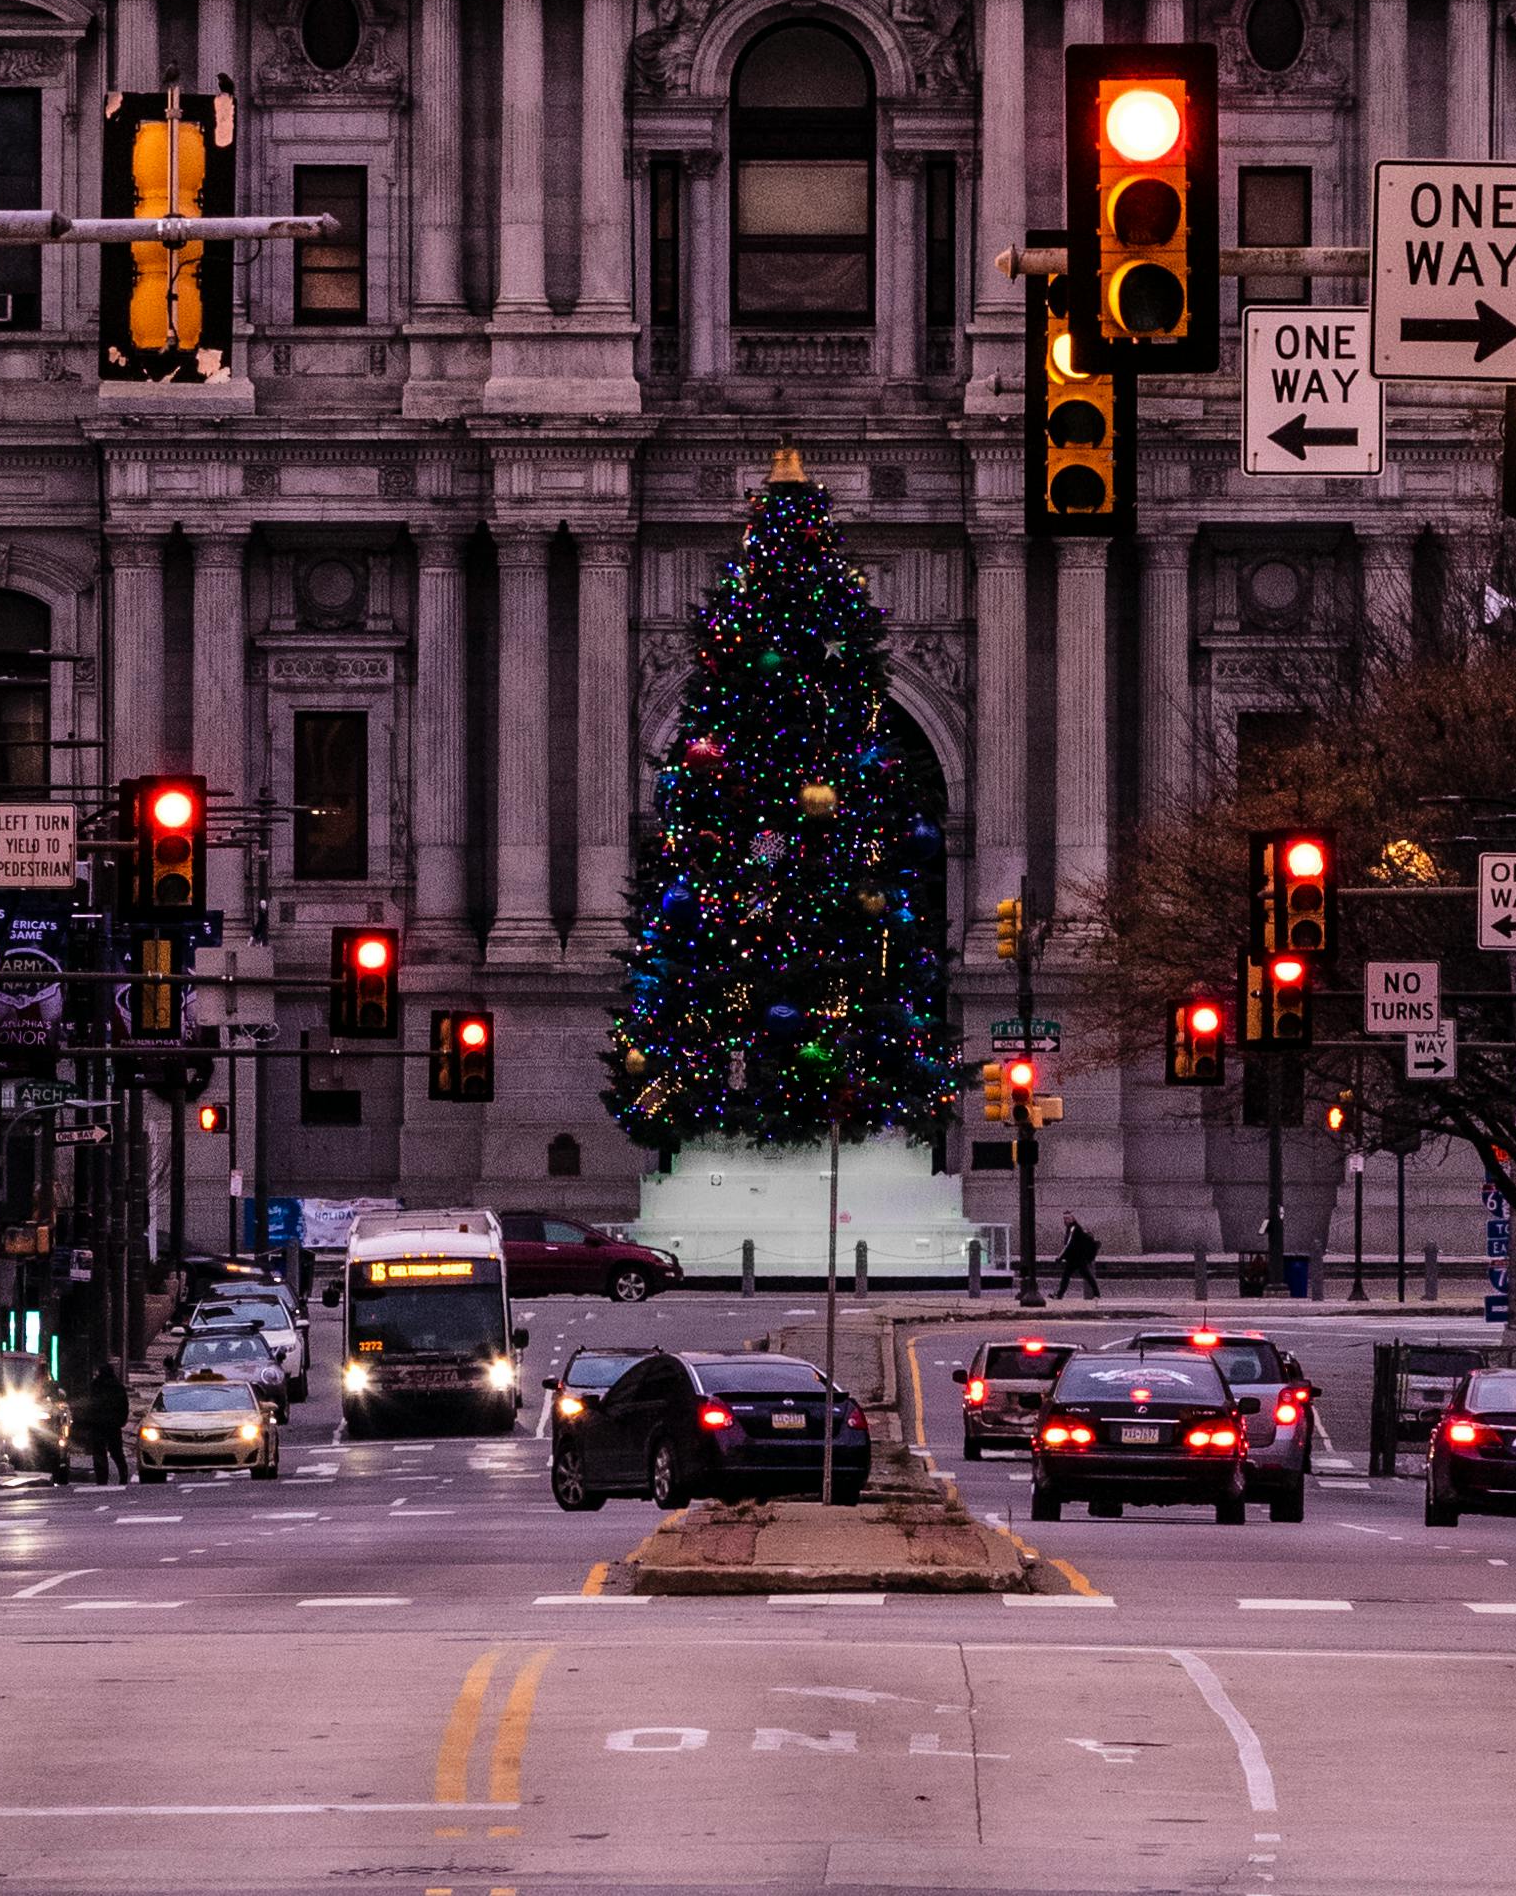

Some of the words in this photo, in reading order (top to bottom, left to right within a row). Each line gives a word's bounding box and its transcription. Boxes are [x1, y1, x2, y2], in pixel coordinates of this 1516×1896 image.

[1275, 325, 1356, 359] ONE
[1272, 369, 1359, 403] WAY
[35, 814, 69, 830] TURN
[6, 838, 40, 854] YIELD
[46, 838, 60, 854] TO
[1383, 972, 1421, 994] NO
[1371, 1002, 1434, 1020] TURNS
[1414, 1040, 1446, 1054] WAY
[21, 1088, 63, 1101] ARCH
[314, 1209, 359, 1221] HOLIDAY
[370, 1262, 386, 1282] 16
[359, 1340, 383, 1351] 3272
